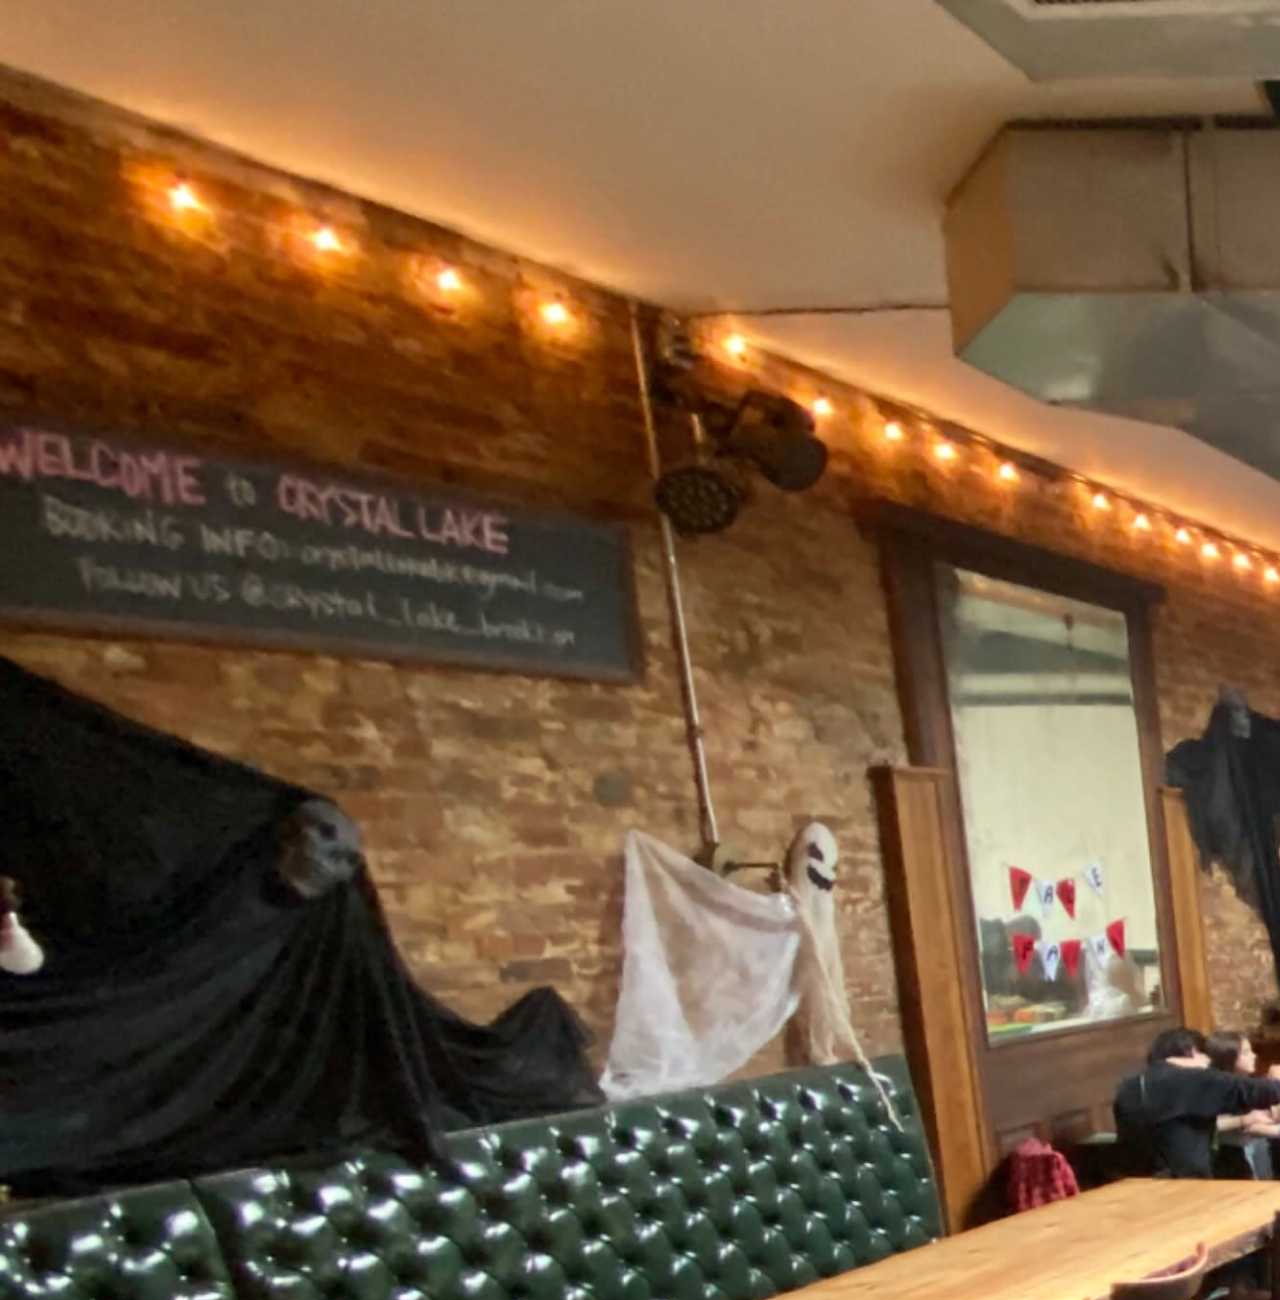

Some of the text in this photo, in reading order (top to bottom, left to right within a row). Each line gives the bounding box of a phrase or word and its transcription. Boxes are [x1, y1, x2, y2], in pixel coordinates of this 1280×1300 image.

[0, 430, 206, 505] WELCOME
[277, 474, 415, 538] CRYSTAL
[416, 504, 509, 556] LAKE
